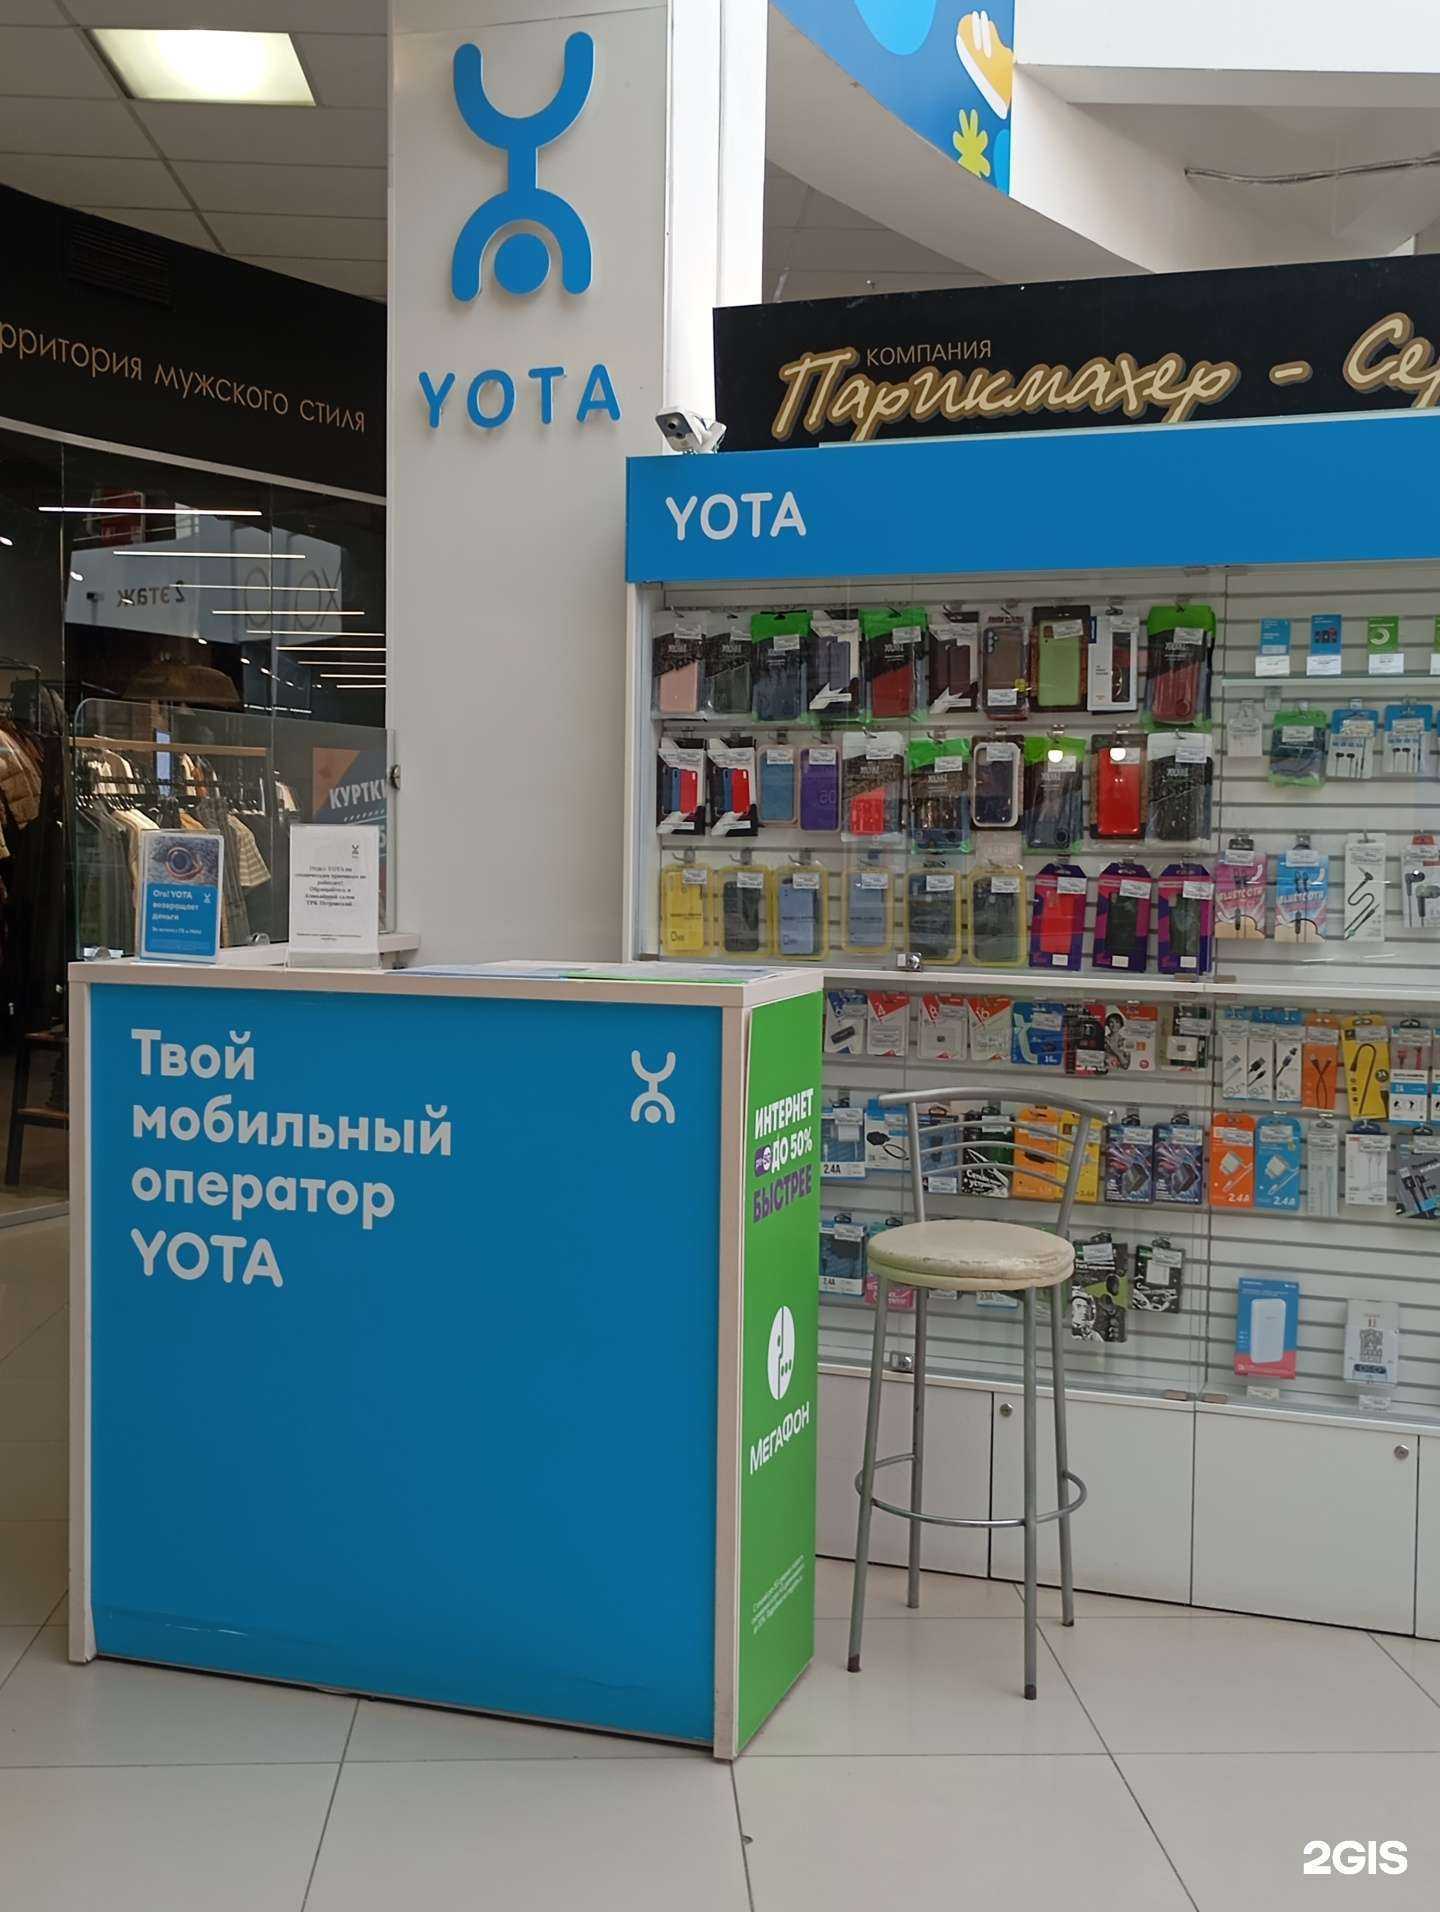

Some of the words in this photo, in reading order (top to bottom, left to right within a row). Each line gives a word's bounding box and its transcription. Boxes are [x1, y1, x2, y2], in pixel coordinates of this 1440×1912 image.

[866, 339, 991, 367] КОМПАНИЯ
[154, 364, 289, 416] мужского
[299, 398, 365, 433] стиля
[418, 364, 622, 430] YOTA
[771, 345, 1241, 442] Парикмахер
[665, 491, 807, 541] YOTA
[171, 890, 193, 899] YOTA
[131, 1028, 255, 1080] Твой
[132, 1094, 452, 1156] мобильный
[754, 1088, 814, 1140] ИНТЕРНЕТ
[771, 1138, 788, 1173] ДО
[790, 1126, 813, 1162] 50%
[824, 1164, 841, 1174] 2.4A
[131, 1167, 395, 1230] оператор
[753, 1163, 812, 1223] БЫСТРЕЕ
[130, 1228, 283, 1288] YOTA
[750, 1400, 810, 1475] МЕГАФОН
